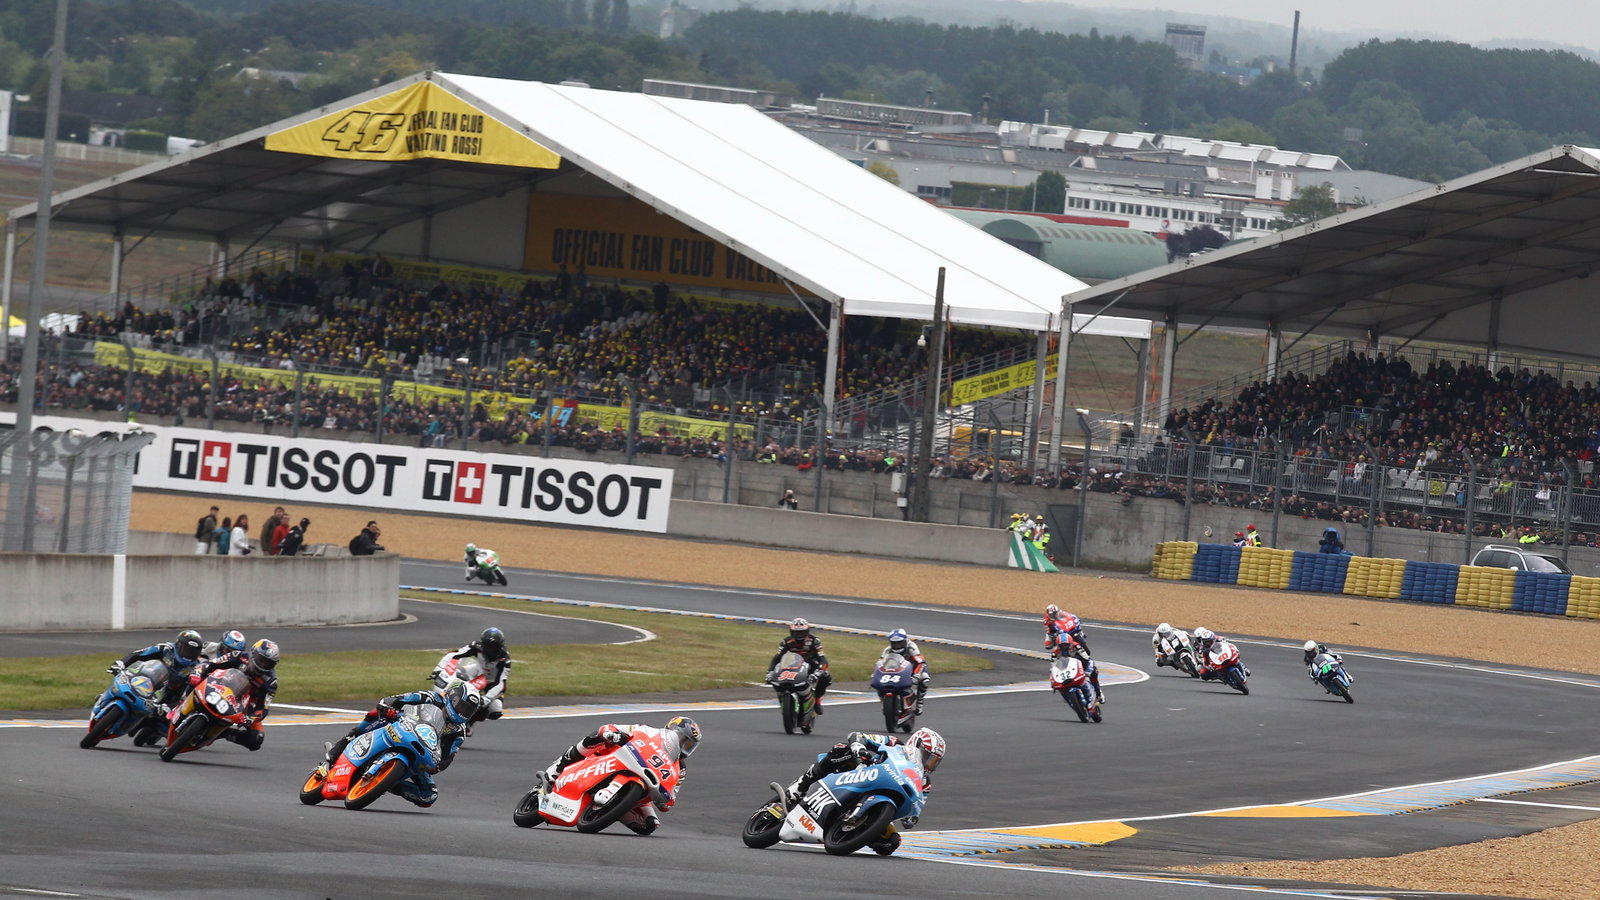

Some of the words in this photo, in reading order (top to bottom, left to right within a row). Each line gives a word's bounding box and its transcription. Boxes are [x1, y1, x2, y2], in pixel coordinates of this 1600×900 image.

[322, 111, 405, 153] 46
[441, 112, 457, 131] FAN
[460, 114, 483, 133] CLUB
[452, 136, 482, 155] ROSSI
[552, 228, 624, 269] OFFICIAL
[631, 234, 663, 272] FAN
[669, 238, 714, 277] CLUB
[237, 443, 407, 497] TISSOT
[491, 463, 662, 520] TISSOT
[880, 674, 901, 683] 84
[1060, 670, 1071, 681] 32
[416, 725, 438, 748] 42
[555, 758, 617, 792] MAPFRE
[648, 754, 671, 781] 94
[835, 768, 878, 786] Calvo
[881, 762, 905, 786] Avintia
[803, 787, 836, 816] JHK
[799, 814, 817, 835] KTM
